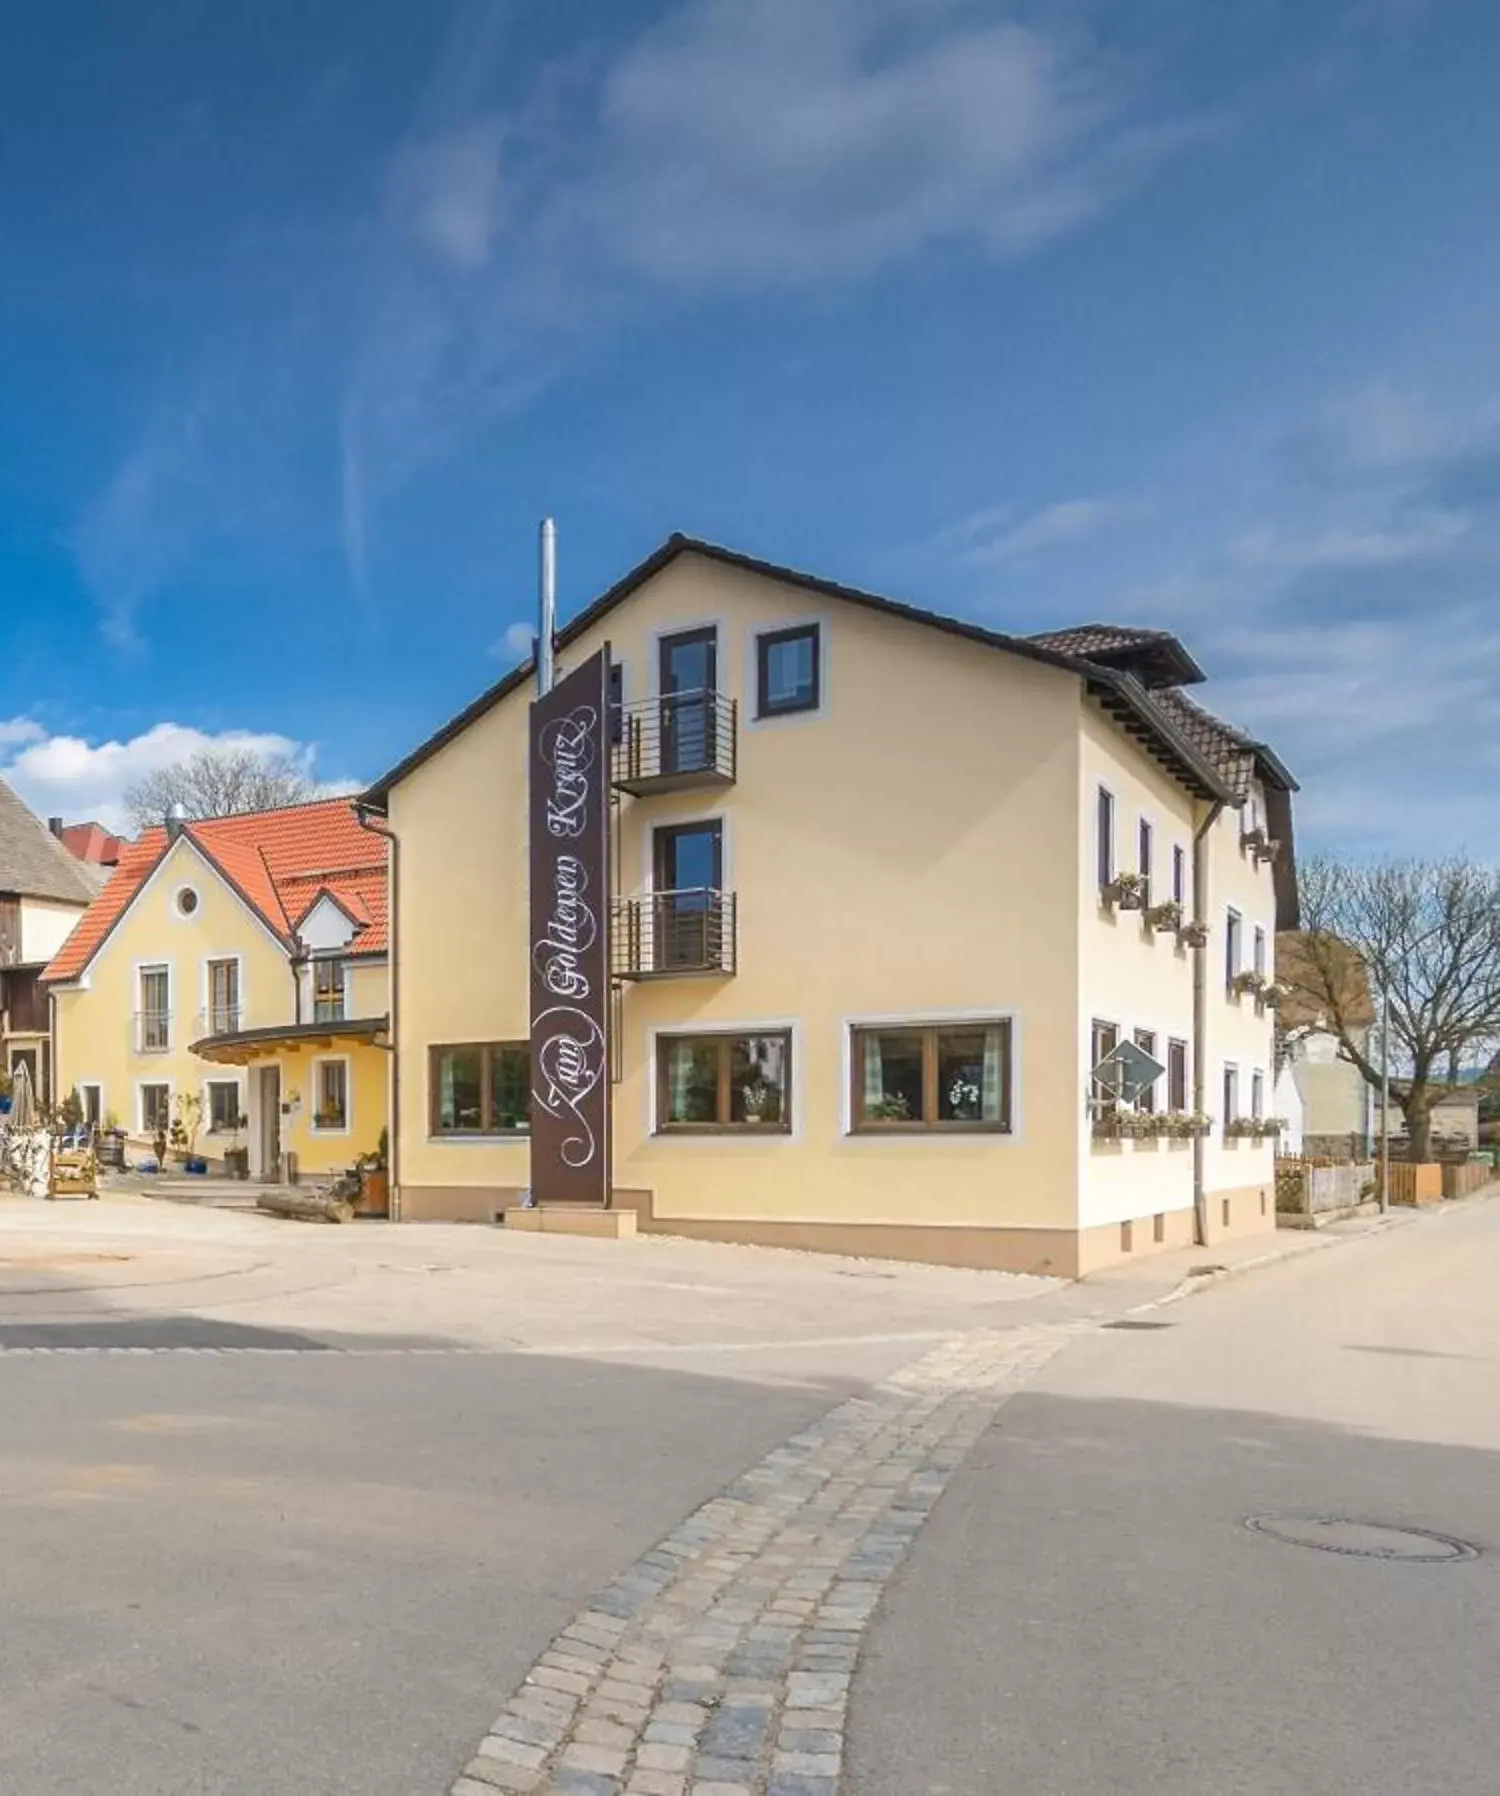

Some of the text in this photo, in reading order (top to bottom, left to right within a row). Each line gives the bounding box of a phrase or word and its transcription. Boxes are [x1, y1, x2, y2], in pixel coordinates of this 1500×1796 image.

[532, 705, 606, 1167] Zum Goldenen Kreuz
